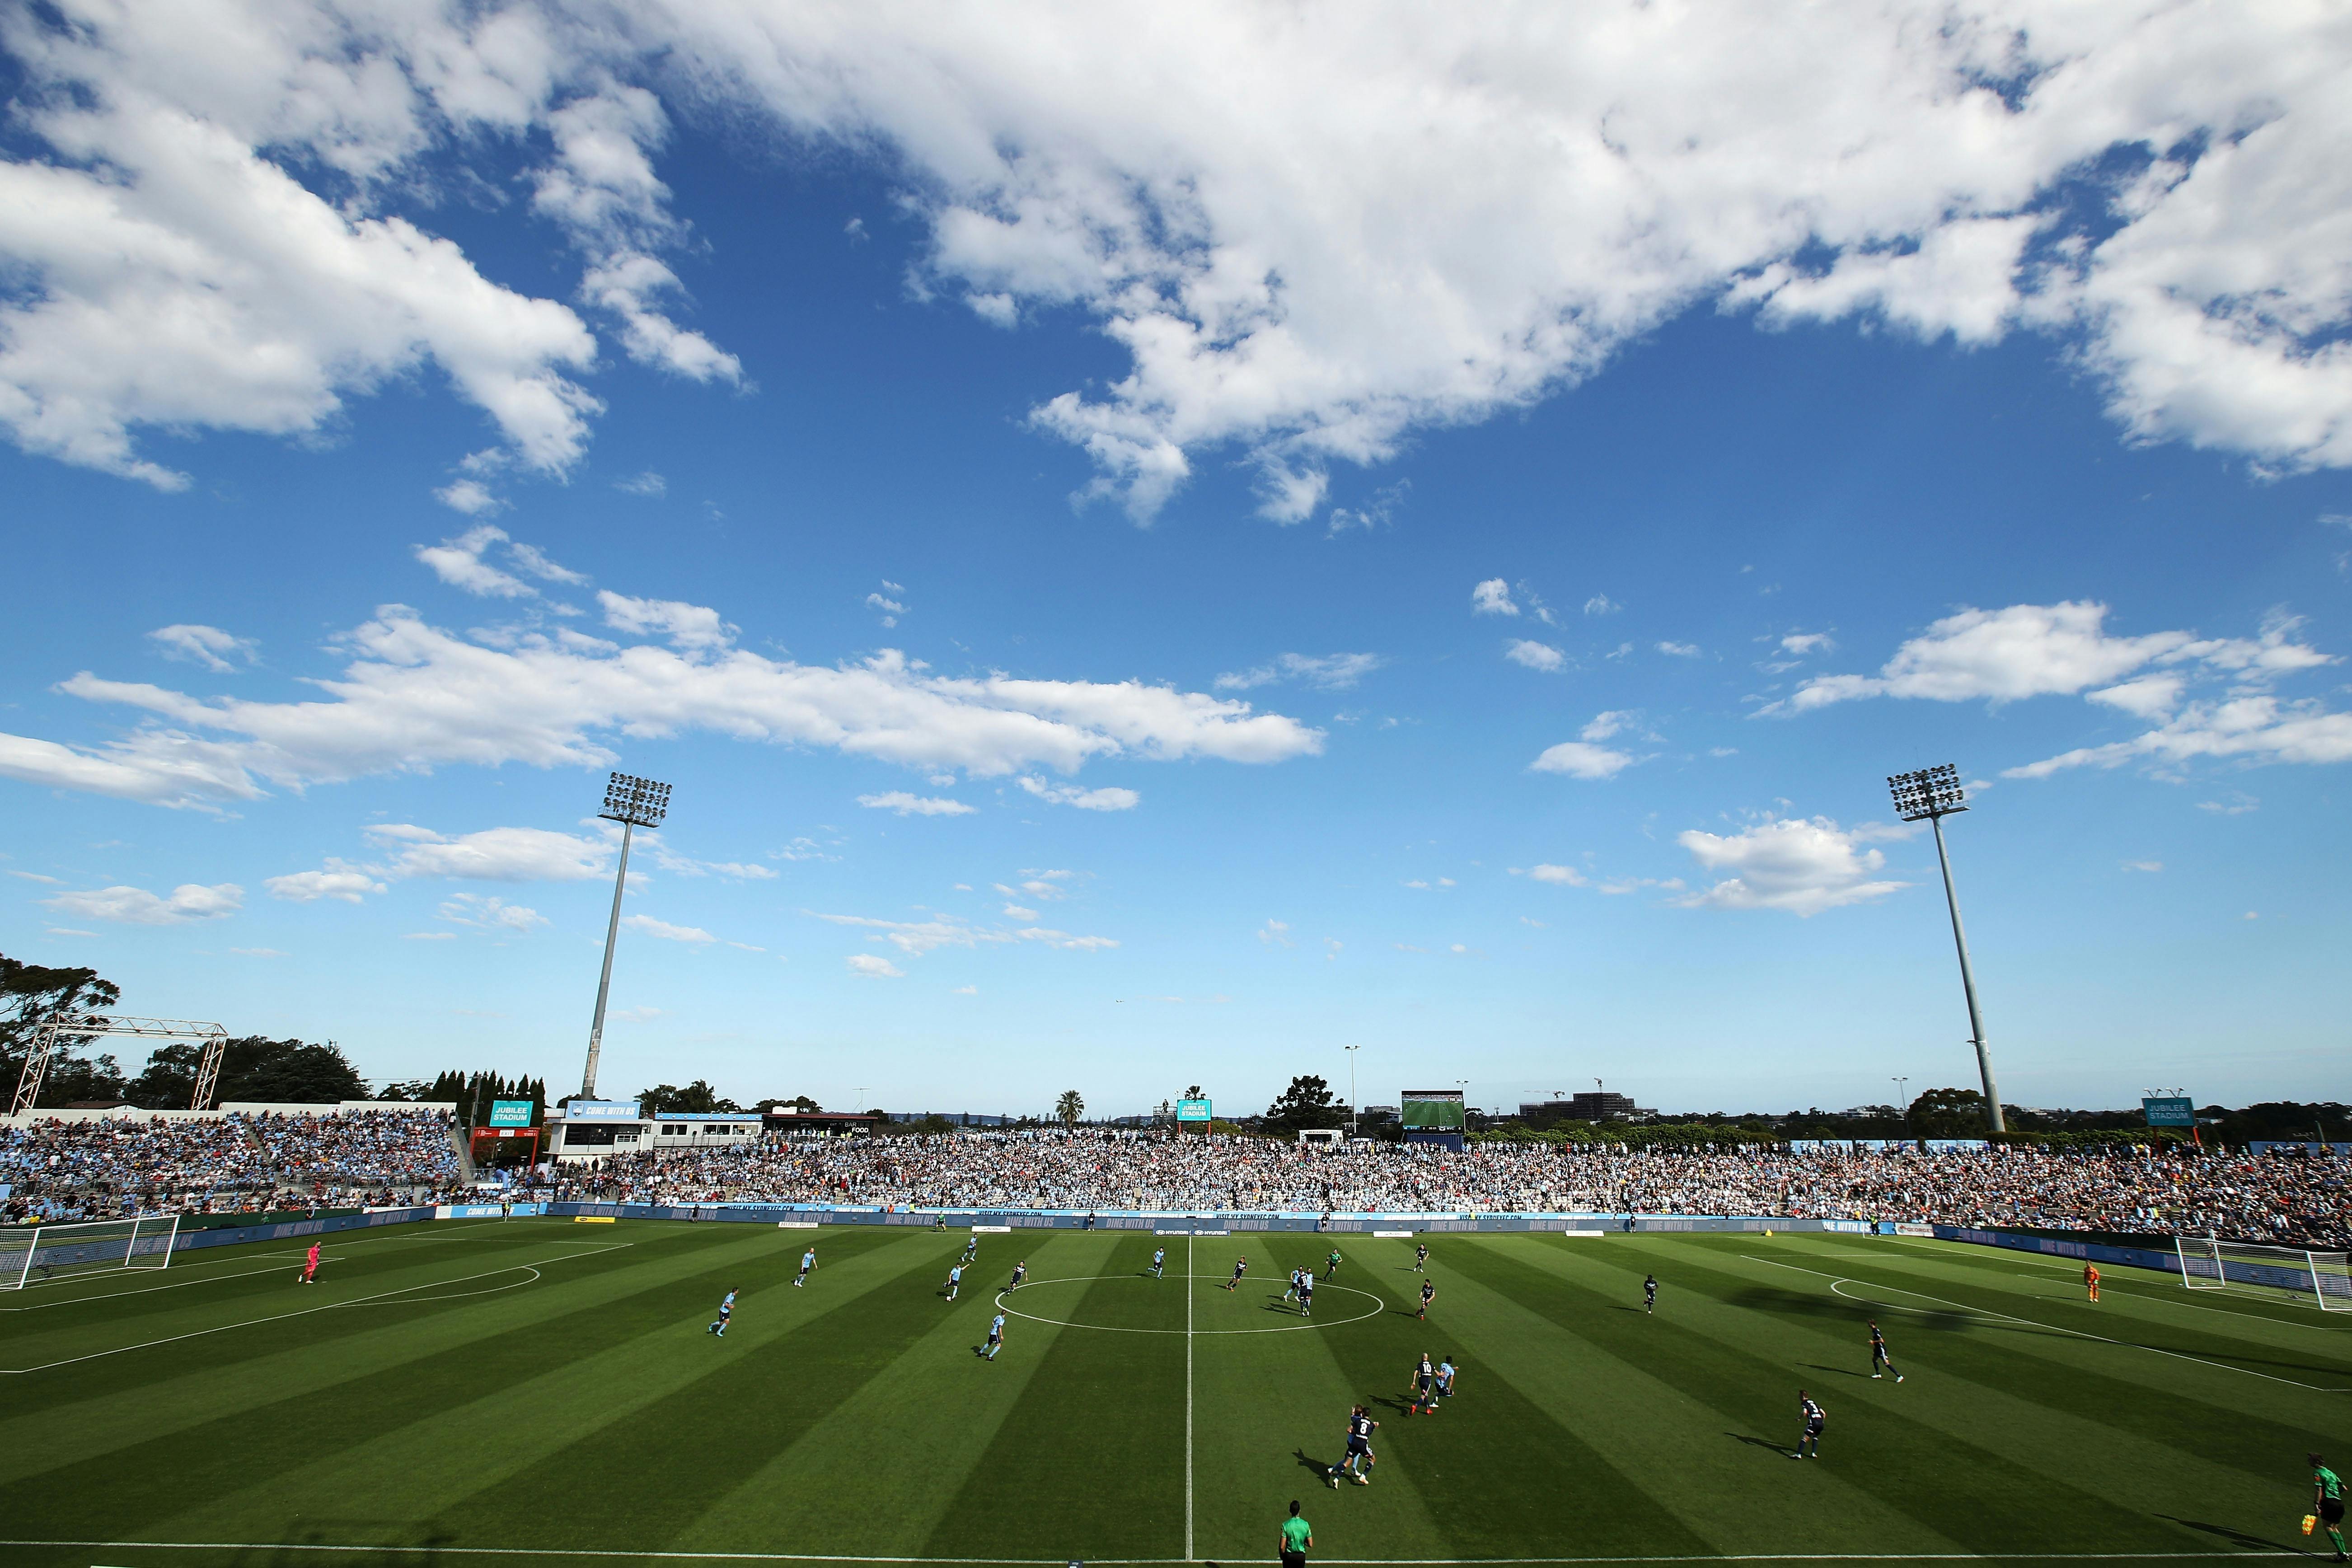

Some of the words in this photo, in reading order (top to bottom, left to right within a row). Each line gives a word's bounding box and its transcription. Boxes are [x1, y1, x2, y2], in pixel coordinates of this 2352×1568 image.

[586, 1107, 606, 1115] COME
[626, 1107, 636, 1115] US
[579, 1205, 595, 1215] DINE
[596, 1206, 614, 1216] WITH
[615, 1207, 625, 1216] US
[671, 1209, 688, 1218] DINE
[707, 1211, 717, 1219] US
[370, 1212, 387, 1225] DINE
[386, 1211, 402, 1223] WITH
[401, 1210, 411, 1222] US
[784, 1212, 801, 1222] DINE
[803, 1212, 822, 1222] WITH
[823, 1213, 834, 1222] US
[885, 1214, 901, 1224] DINE
[904, 1215, 923, 1224] WITH
[923, 1215, 935, 1224] US
[1005, 1217, 1022, 1226] DINE
[1024, 1217, 1043, 1226] WITH
[1044, 1217, 1054, 1226] US
[274, 1223, 294, 1237] DINE
[293, 1221, 314, 1235] WITH
[313, 1219, 325, 1232] US
[1106, 1219, 1124, 1228] DINE
[1125, 1219, 1144, 1228] WITH
[1145, 1219, 1156, 1228] US
[1223, 1220, 1239, 1229] DINE
[1242, 1220, 1258, 1229] WITH
[1259, 1220, 1269, 1229] US
[1334, 1221, 1352, 1231] WITH
[1353, 1222, 1363, 1231] US
[1430, 1221, 1447, 1231] DINE
[1448, 1221, 1467, 1231] WITH
[1468, 1221, 1479, 1231] US
[1529, 1221, 1546, 1230] DINE
[1547, 1221, 1566, 1230] WITH
[1567, 1221, 1577, 1230] US
[1646, 1221, 1662, 1230] DINE
[1664, 1221, 1682, 1230] WITH
[1683, 1221, 1693, 1231] US
[1743, 1221, 1759, 1230] DINE
[1762, 1221, 1779, 1230] WITH
[1780, 1222, 1790, 1231] US
[1837, 1222, 1858, 1231] WITH
[1860, 1223, 1871, 1232] US
[178, 1234, 195, 1248] US
[2040, 1239, 2056, 1252] DINE
[2057, 1241, 2075, 1254] WITH
[2076, 1244, 2087, 1256] US
[1423, 1364, 1432, 1373] 10
[1810, 1403, 1818, 1413] 3
[1360, 1423, 1368, 1434] 8
